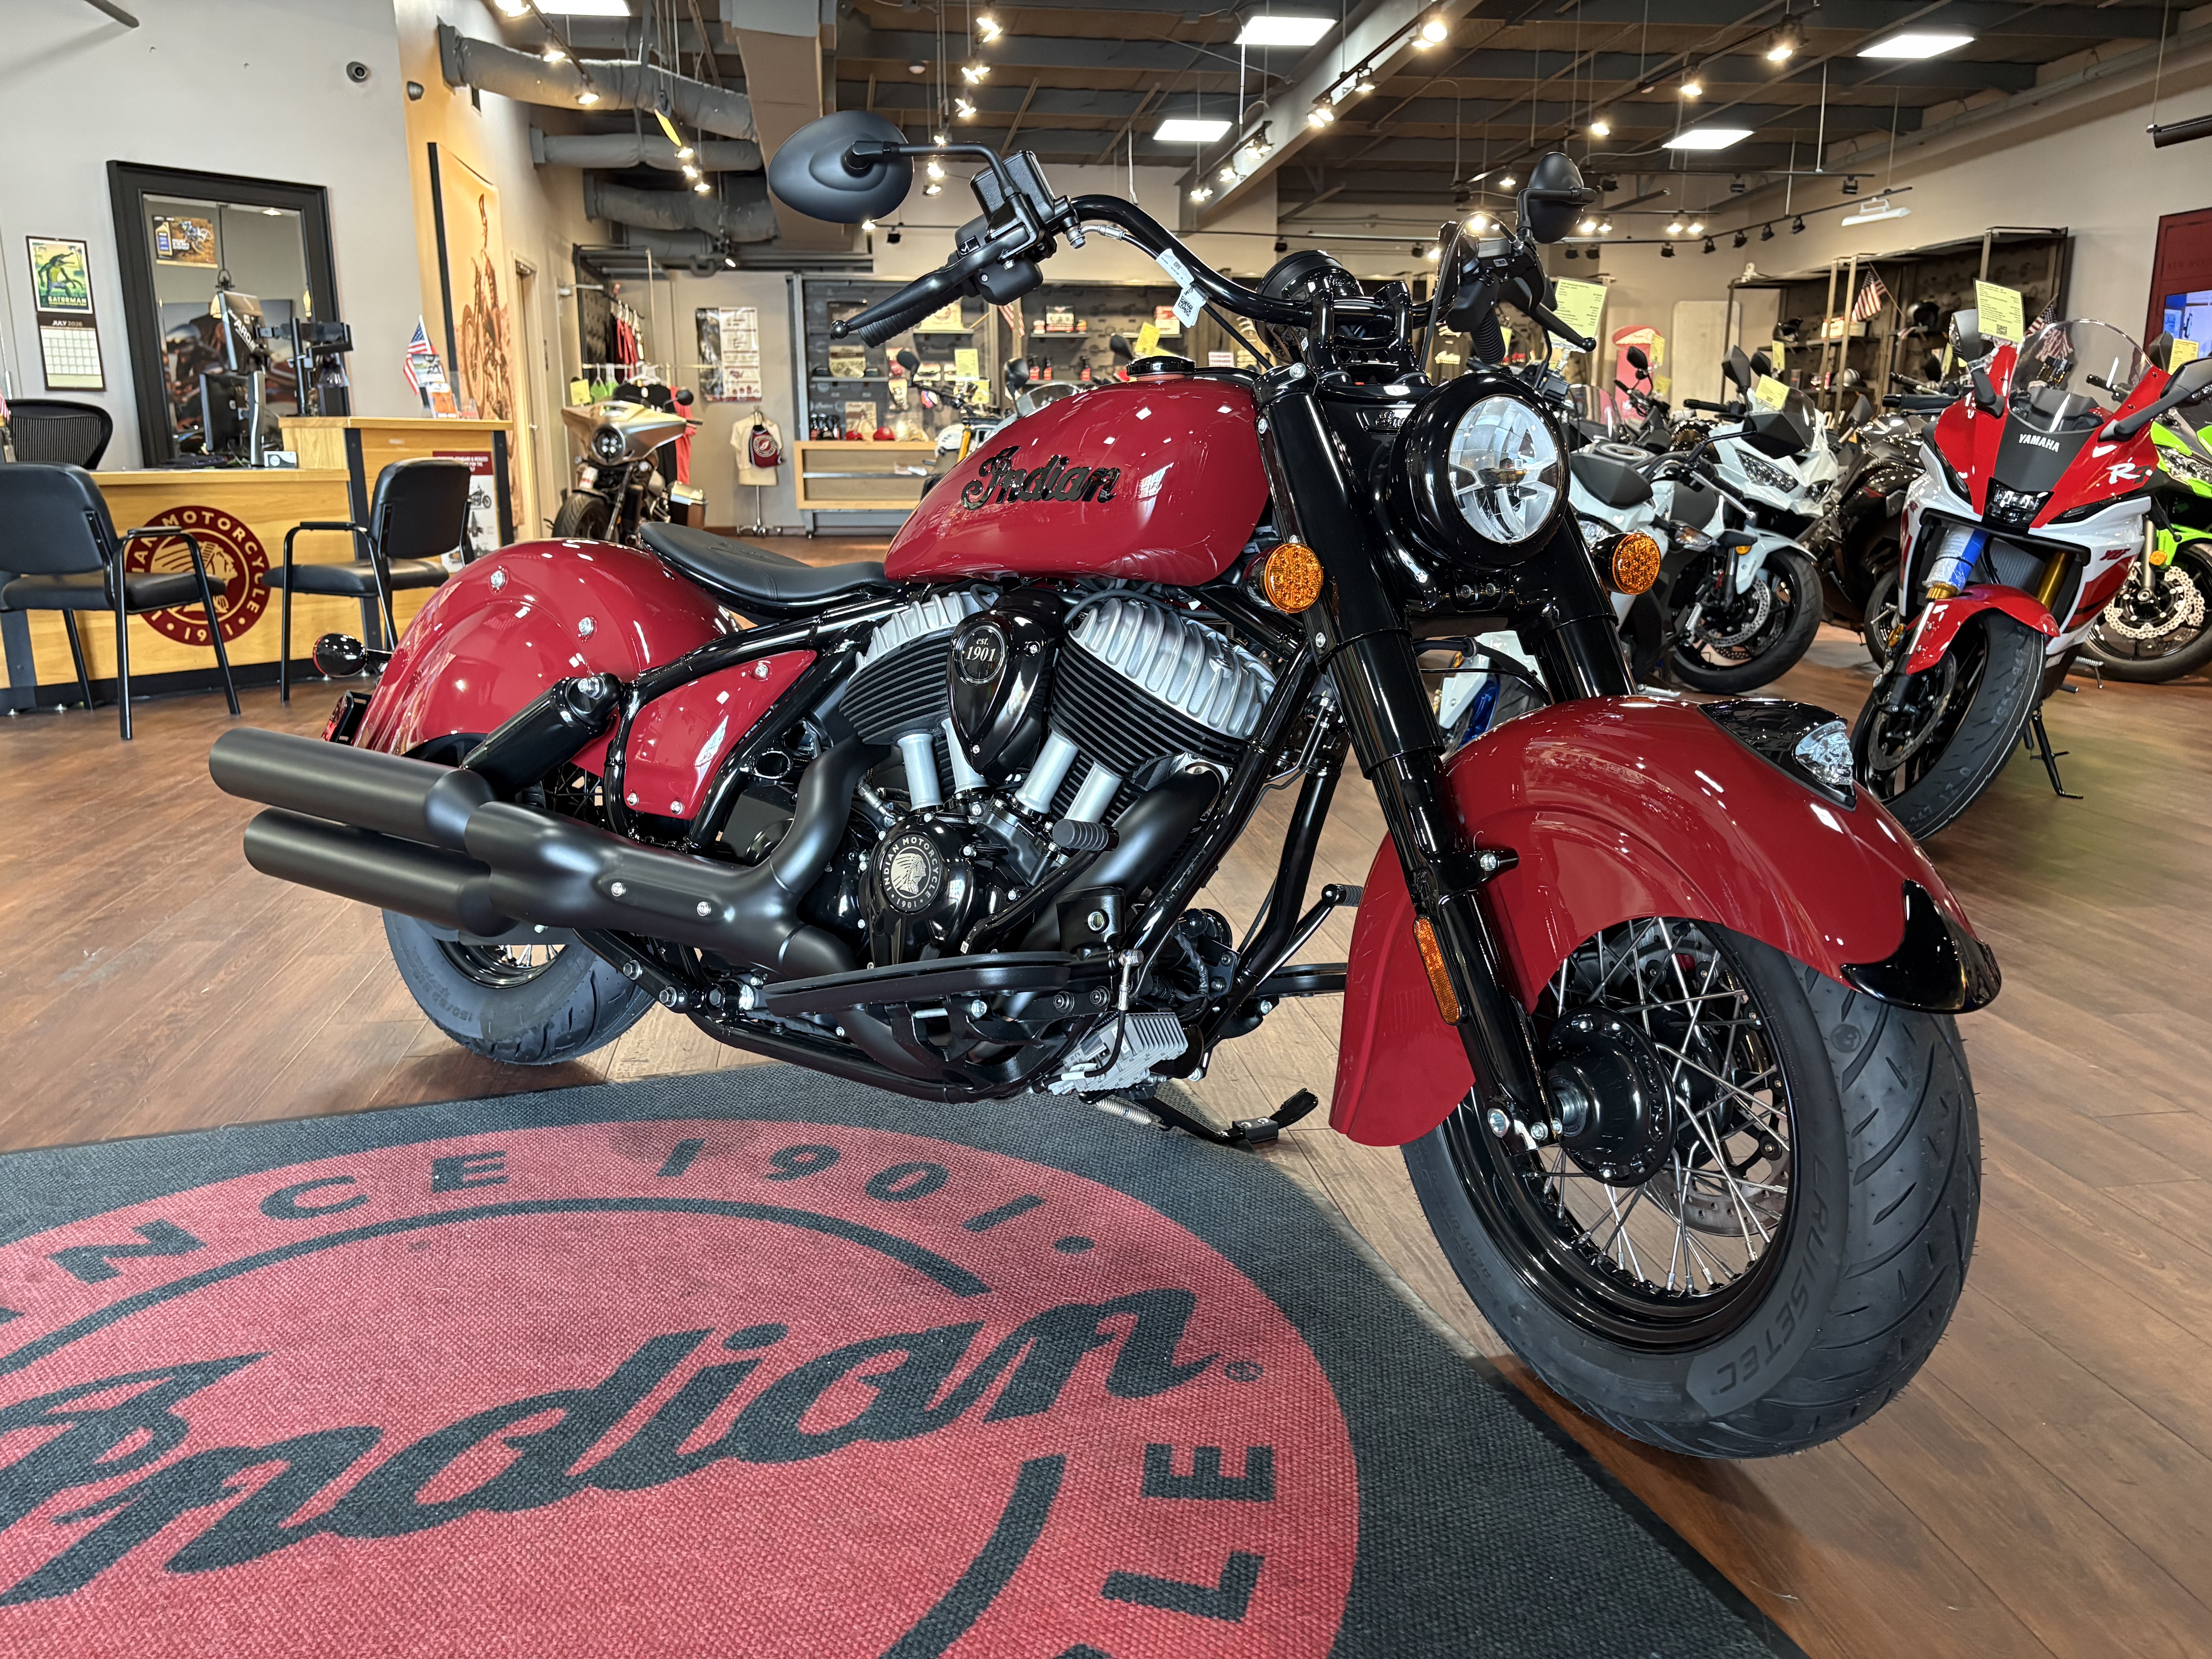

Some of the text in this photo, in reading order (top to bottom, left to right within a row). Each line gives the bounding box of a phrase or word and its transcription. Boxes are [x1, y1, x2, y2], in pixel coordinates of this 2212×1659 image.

[2019, 433, 2060, 453] YAMAHA
[961, 445, 1121, 510] Indian
[161, 510, 265, 613] MOTORCYCLE
[184, 624, 233, 642] 191
[966, 646, 996, 662] 1901
[884, 836, 939, 898] INDIAN MOTORCYCLE
[896, 898, 917, 908] 1901
[0, 1150, 509, 1324] NCE
